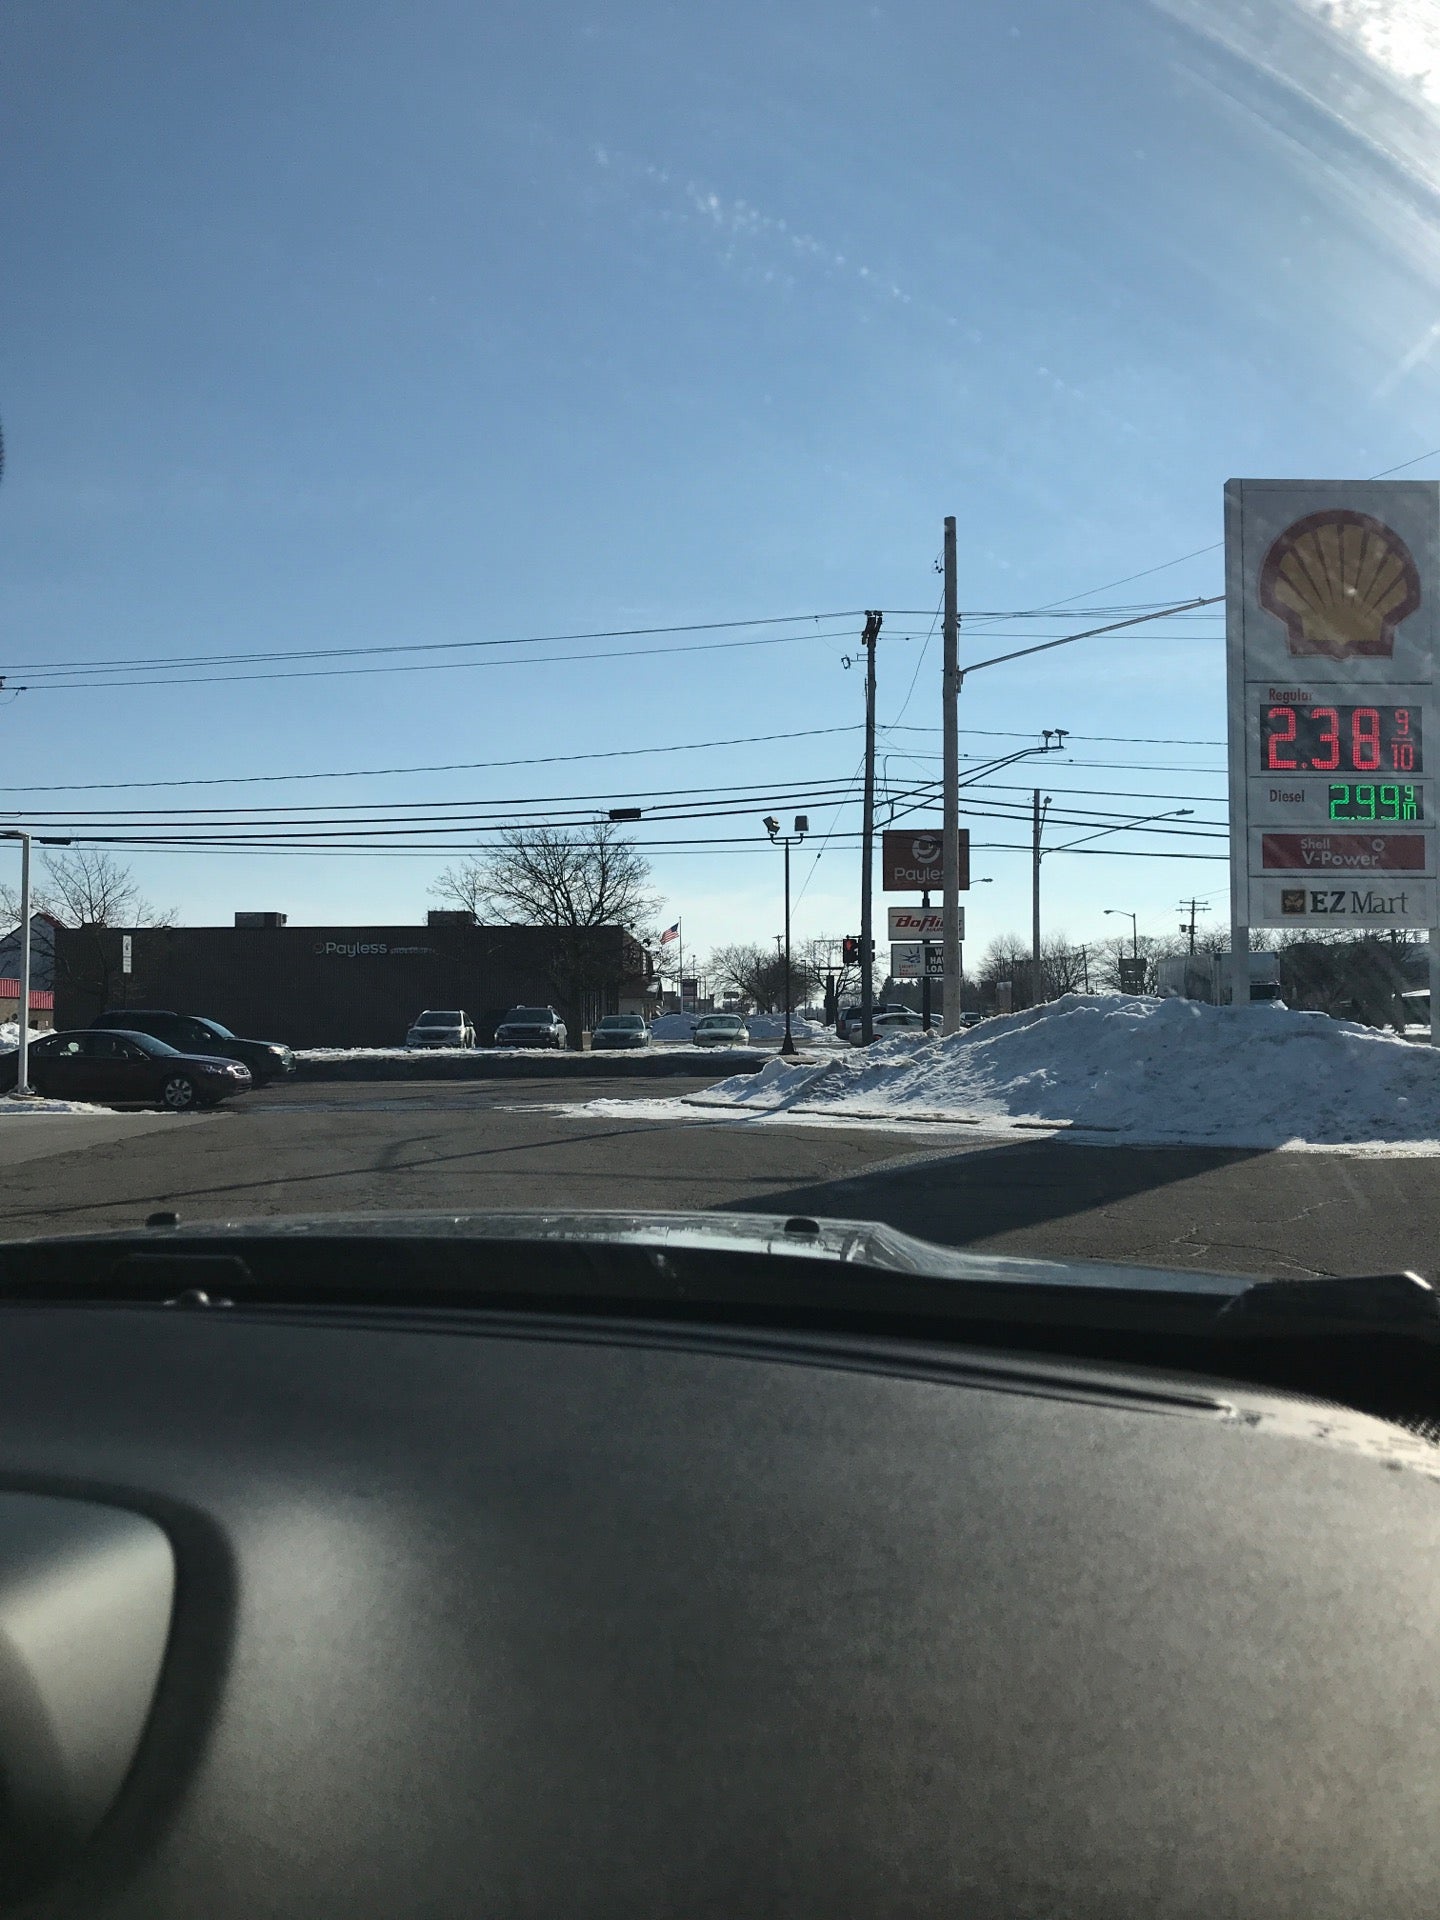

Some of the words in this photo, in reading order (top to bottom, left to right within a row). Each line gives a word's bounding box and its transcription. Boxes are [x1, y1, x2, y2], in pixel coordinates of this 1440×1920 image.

[1269, 688, 1312, 703] Regular
[1268, 707, 1381, 770] 2.38
[1391, 744, 1414, 770] 10
[1269, 789, 1305, 803] Diesel
[1330, 783, 1400, 821] 2.99
[1300, 838, 1330, 849] Shell
[1302, 850, 1380, 866] V-Power
[1310, 890, 1346, 913] EZ
[1351, 890, 1408, 914] Mart
[325, 941, 387, 957] Payless
[926, 965, 944, 973] LOA
